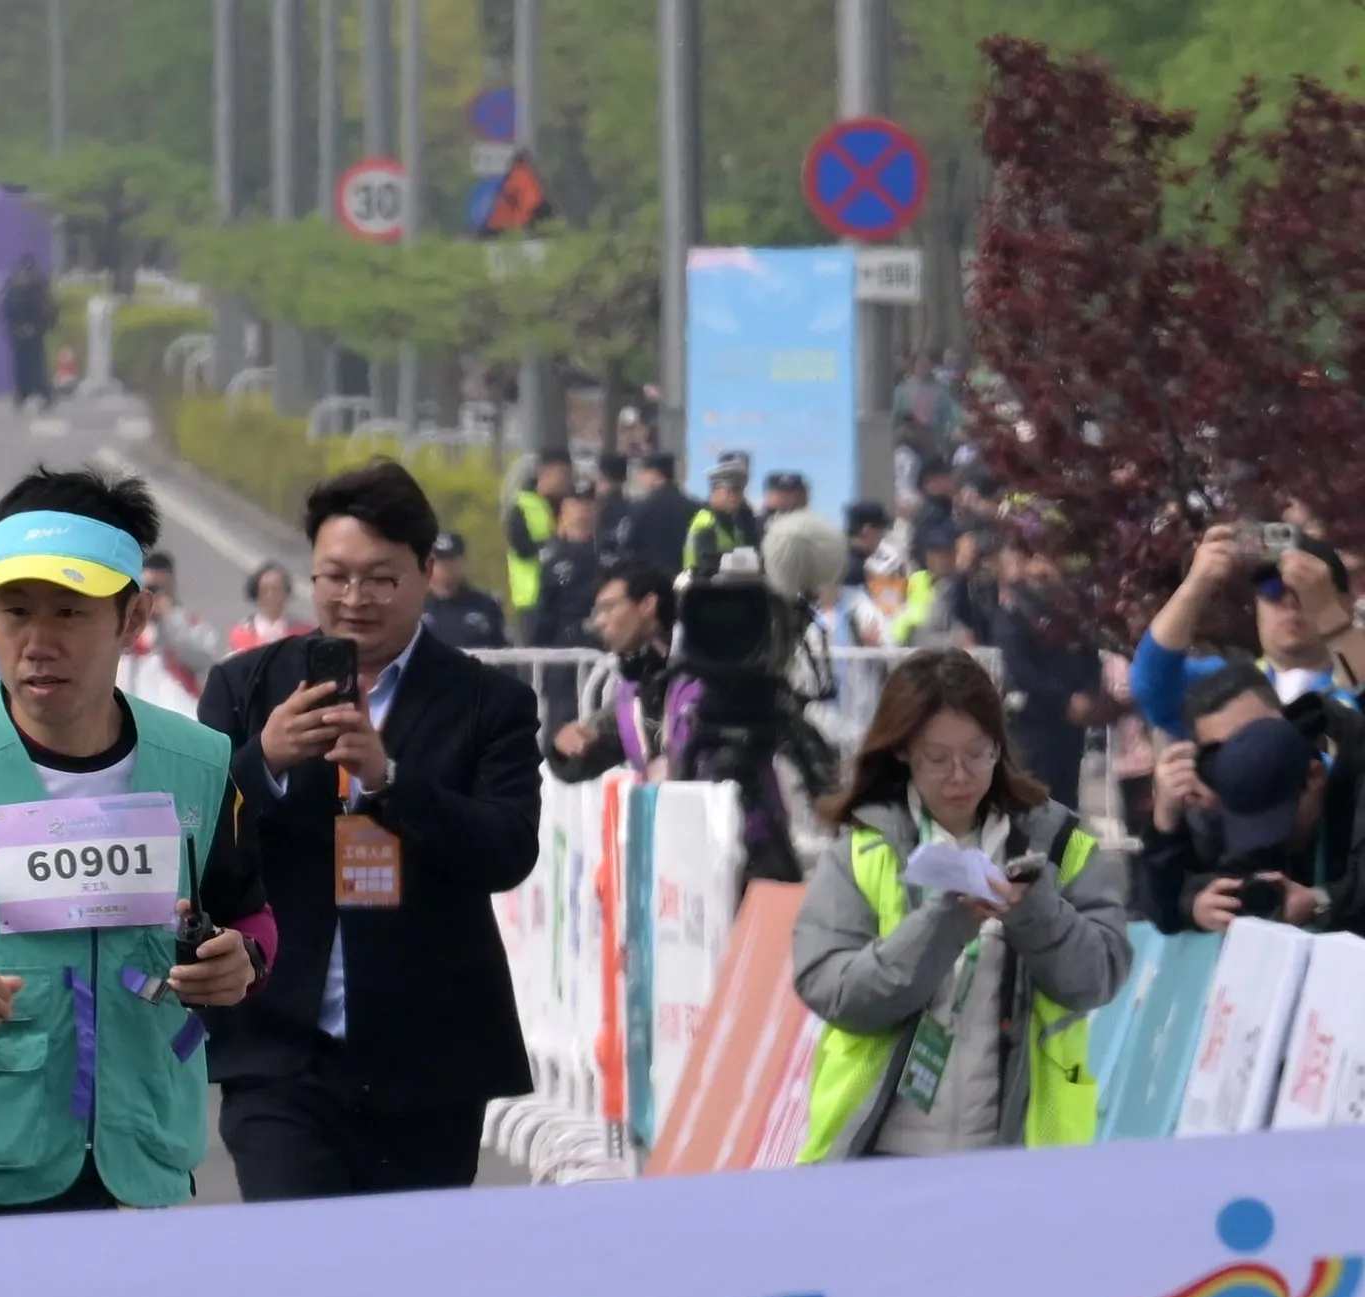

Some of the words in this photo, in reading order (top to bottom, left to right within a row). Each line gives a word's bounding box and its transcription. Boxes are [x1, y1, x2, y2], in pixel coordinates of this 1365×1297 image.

[354, 183, 403, 221] 30
[27, 843, 153, 882] 60901
[81, 881, 110, 893] 天工队
